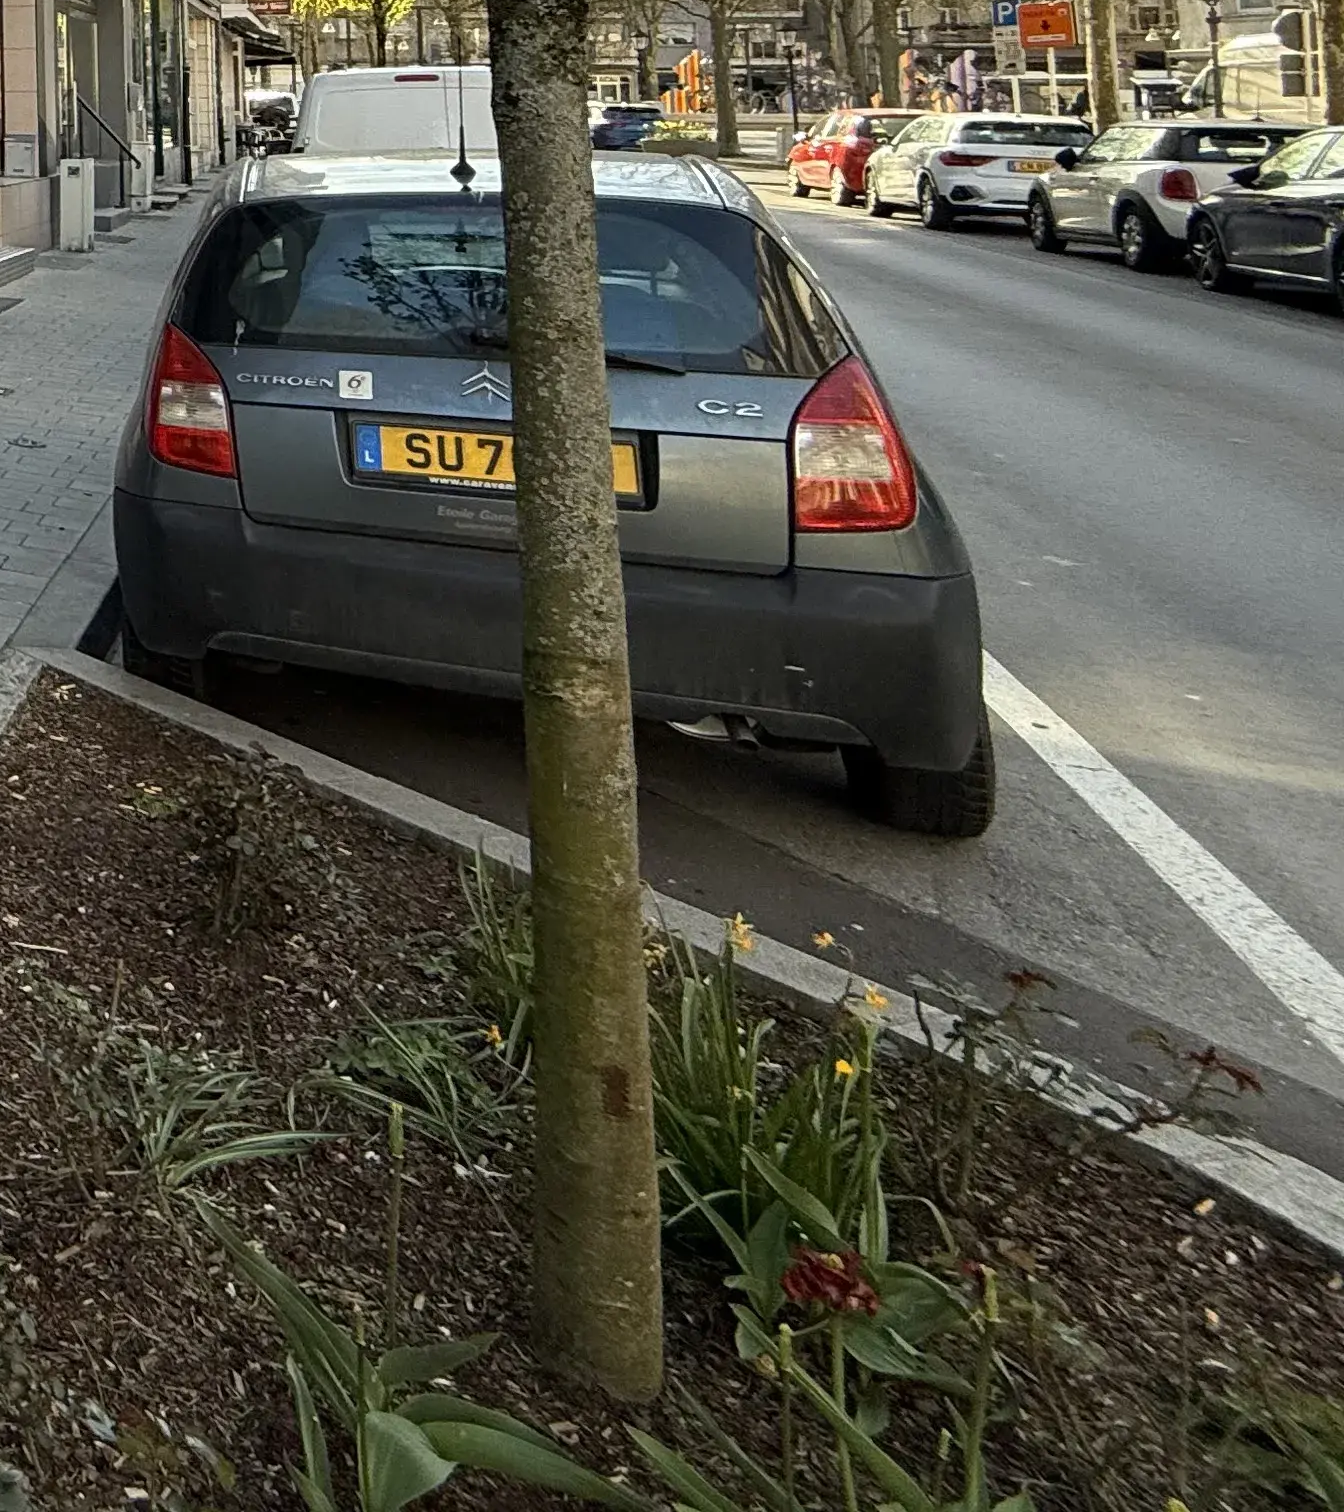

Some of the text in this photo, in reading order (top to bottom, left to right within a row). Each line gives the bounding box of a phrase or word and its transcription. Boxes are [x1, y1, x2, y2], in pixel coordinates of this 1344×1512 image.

[998, 2, 1013, 23] P
[697, 399, 764, 417] C2
[364, 450, 374, 463] L
[405, 433, 515, 476] SU 7
